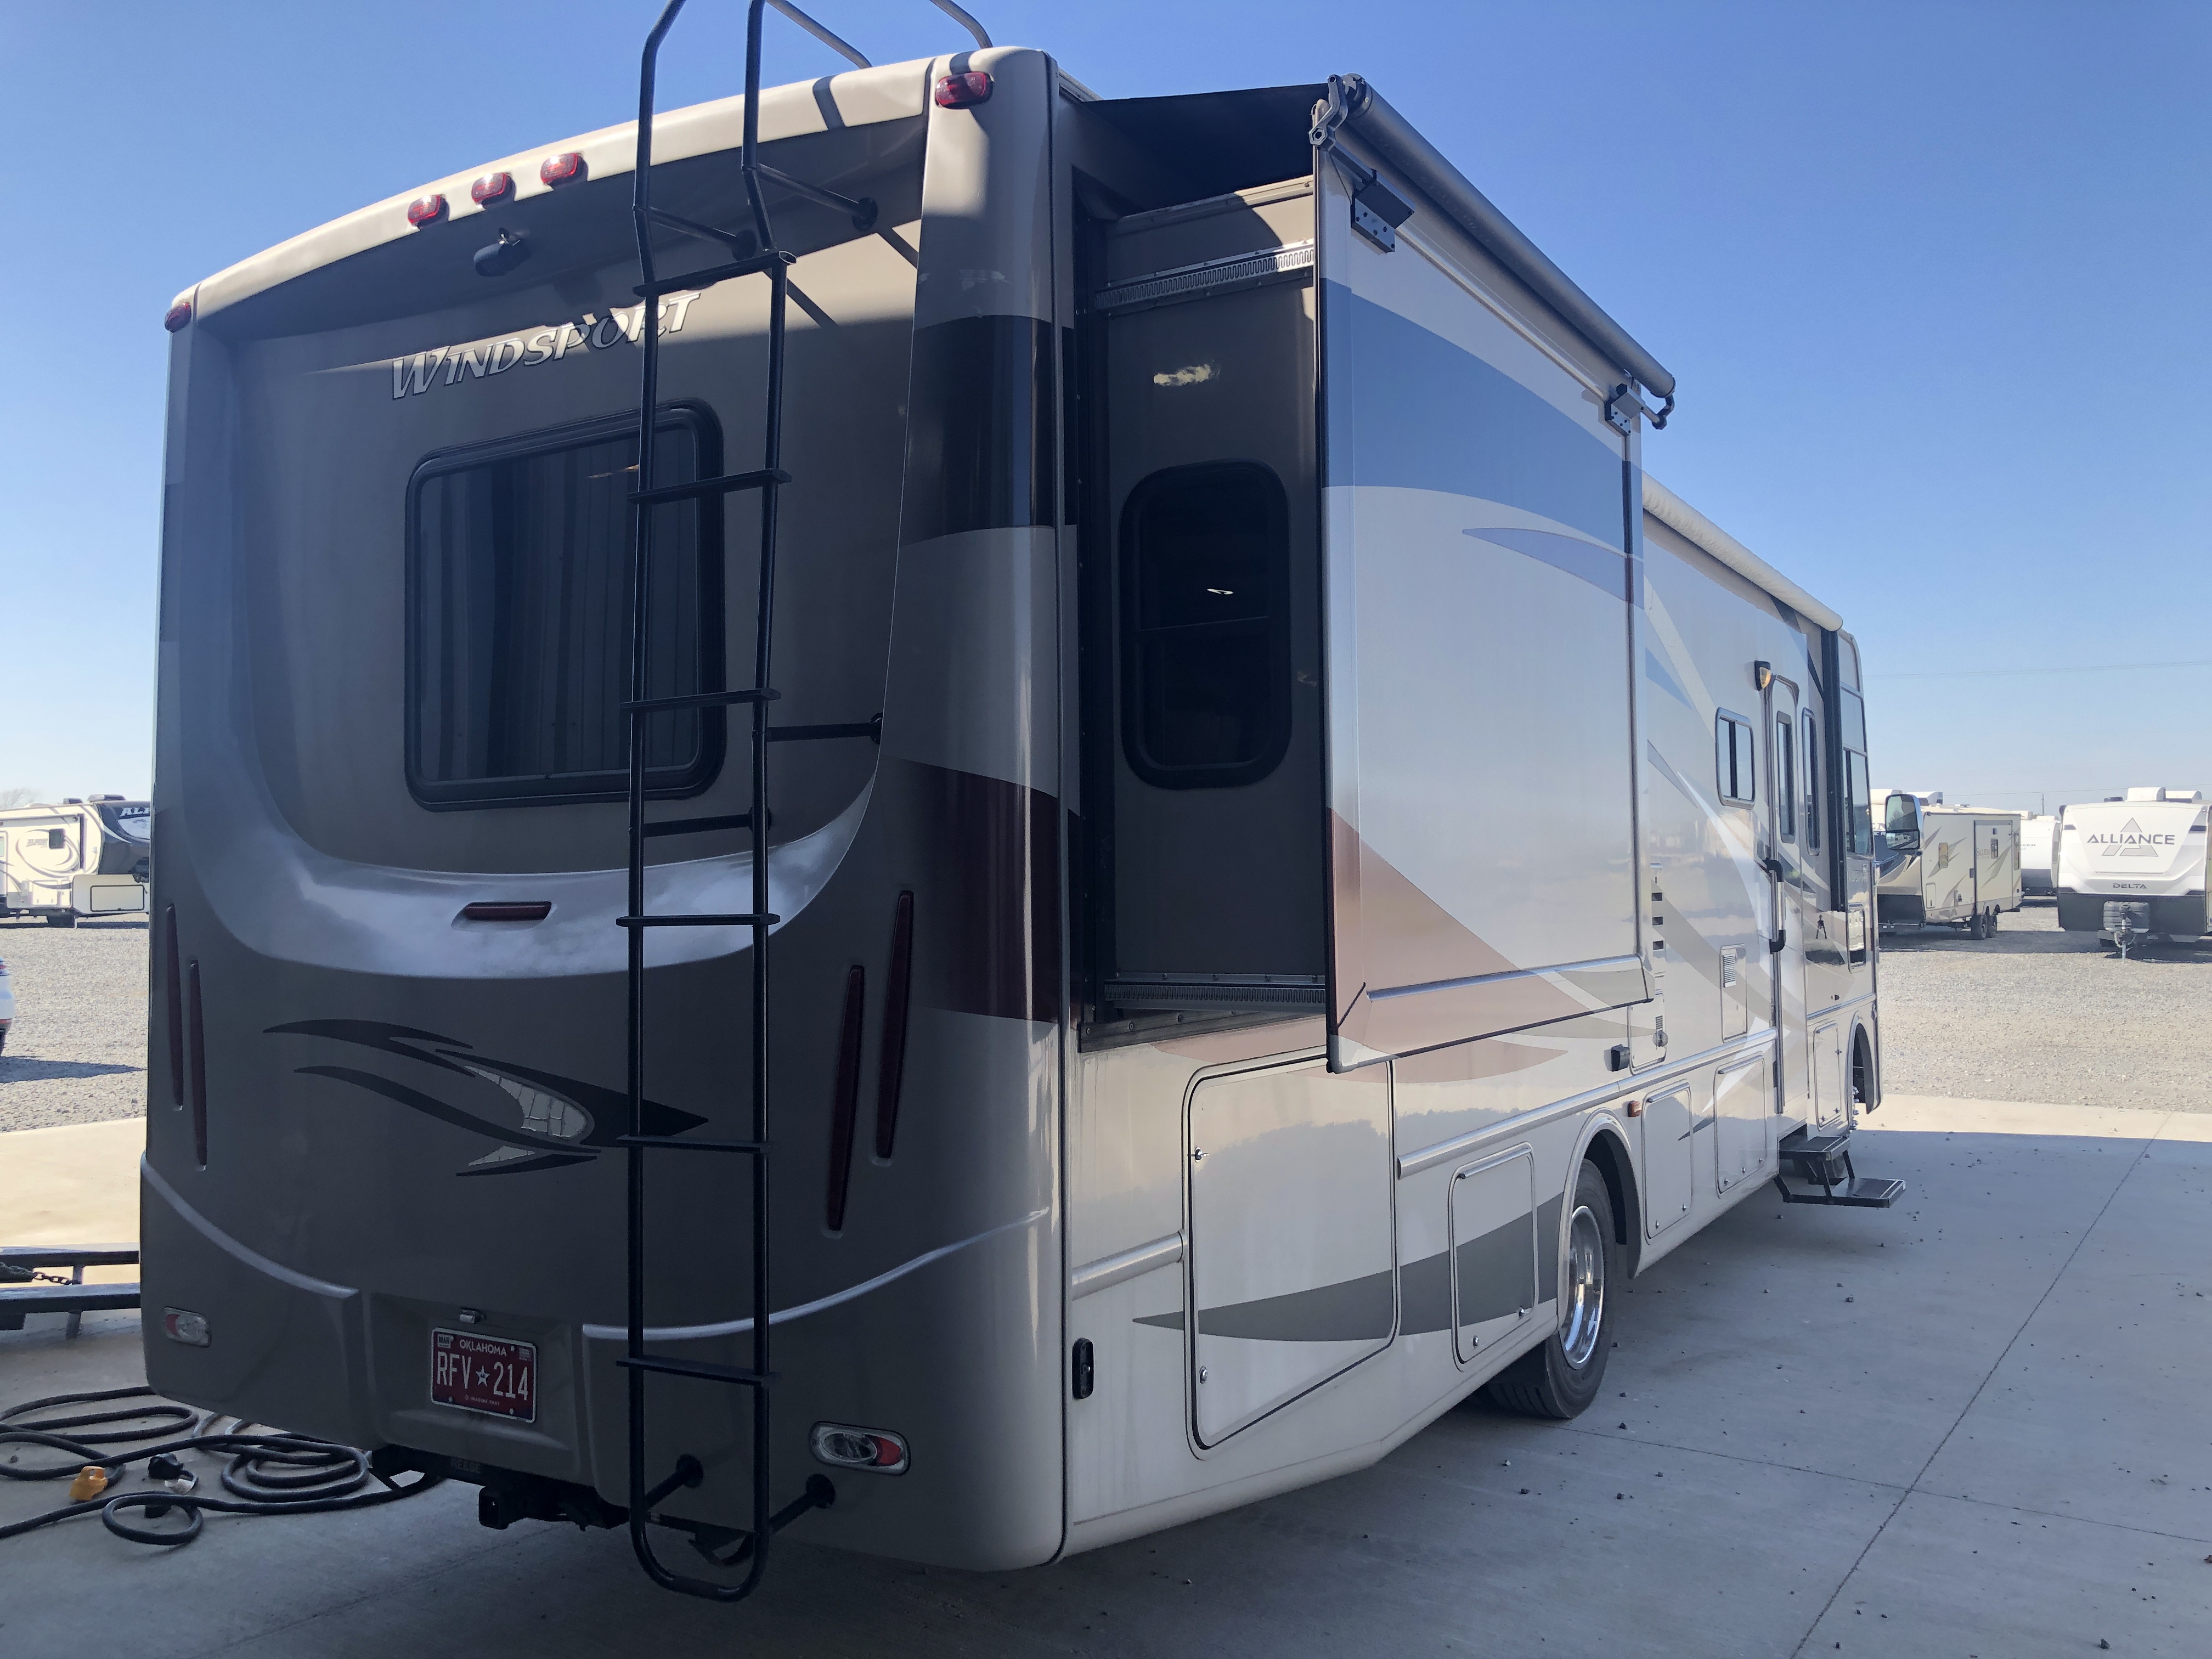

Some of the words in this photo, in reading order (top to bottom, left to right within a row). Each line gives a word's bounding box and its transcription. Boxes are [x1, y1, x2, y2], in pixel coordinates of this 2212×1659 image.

[392, 291, 702, 400] WINDSPORT
[2086, 833, 2175, 845] ALLIANCE
[460, 1339, 507, 1356] OKLAHOMA
[437, 1351, 472, 1389] RFV
[493, 1362, 528, 1401] 214
